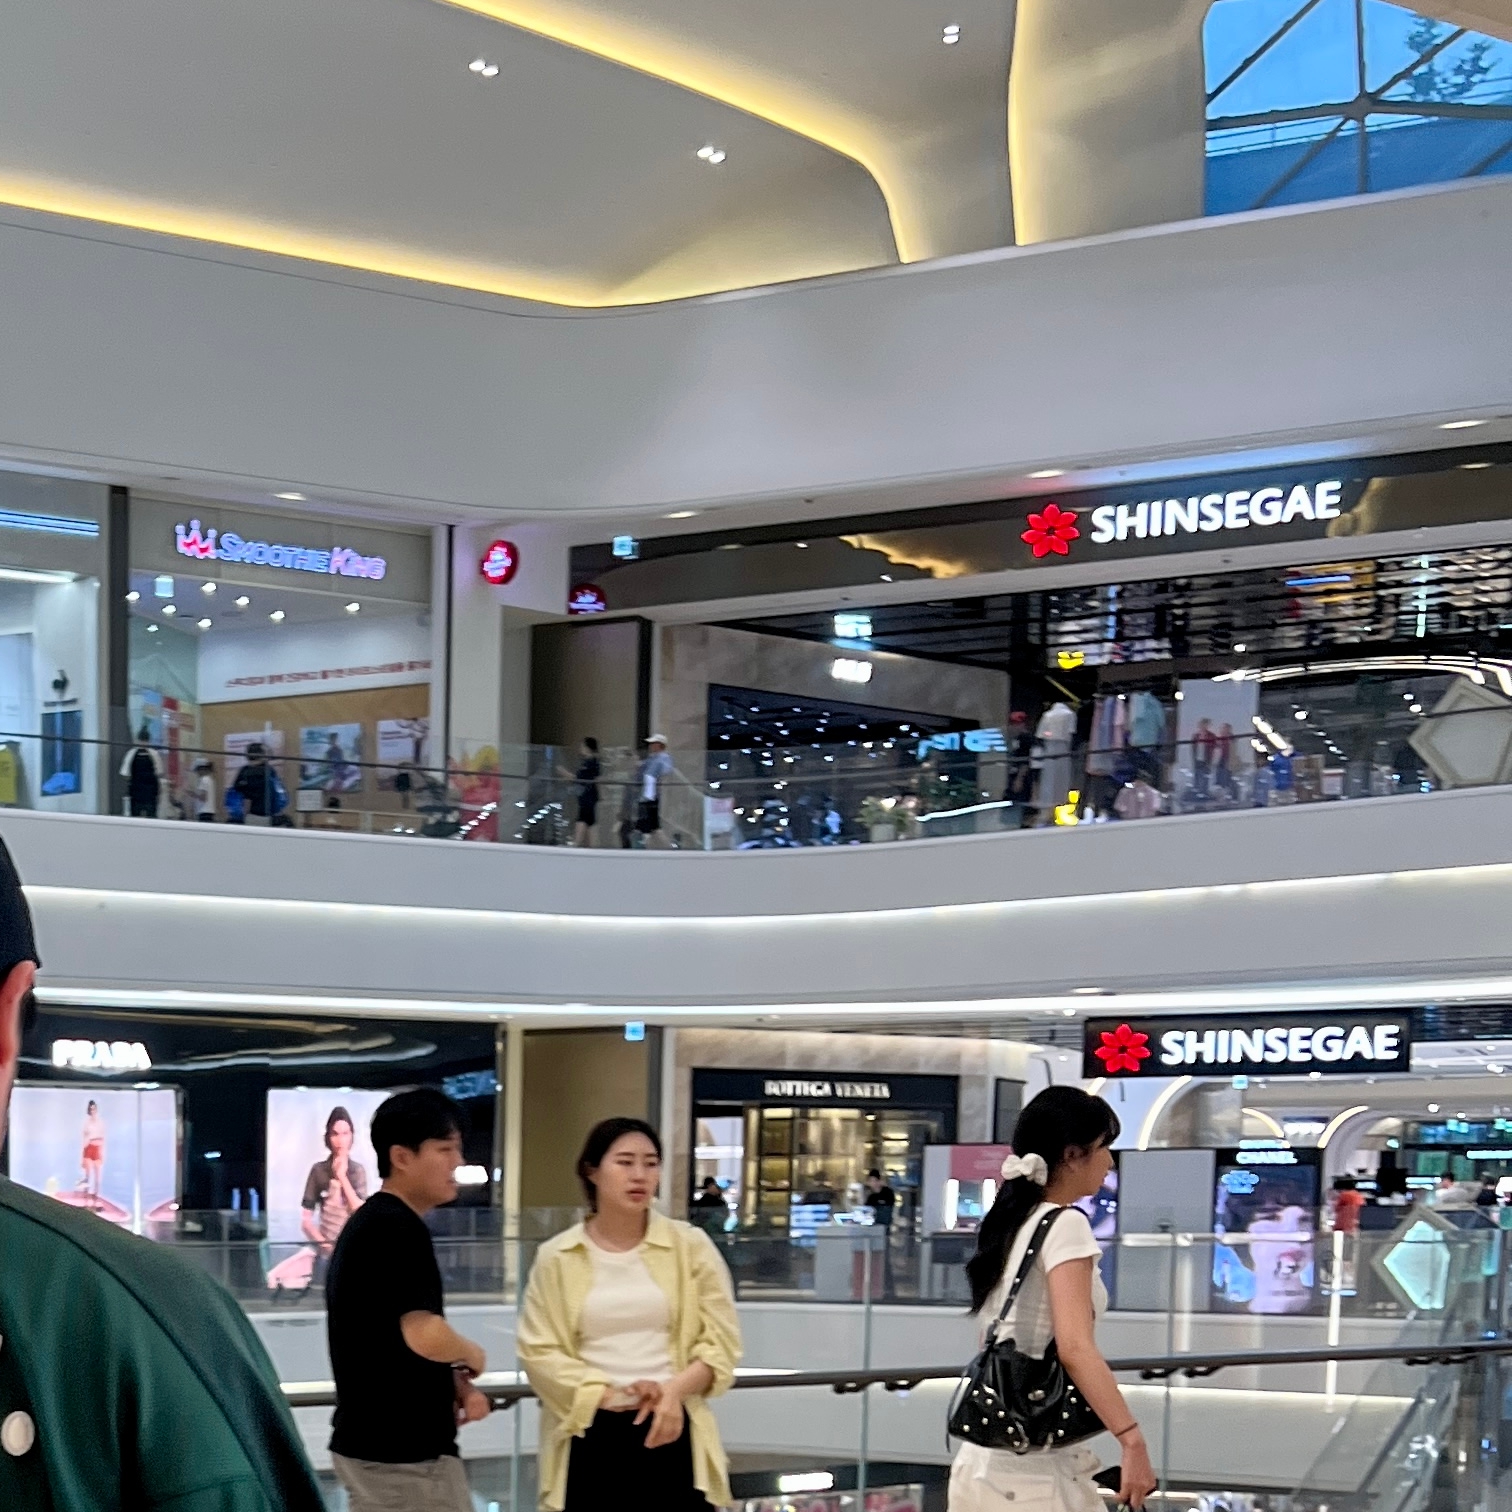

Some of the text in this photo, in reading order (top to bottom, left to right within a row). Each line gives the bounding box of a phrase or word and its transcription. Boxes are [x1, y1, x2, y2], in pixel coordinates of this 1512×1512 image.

[1091, 480, 1342, 544] SHINSEGAE
[52, 1038, 152, 1071] PRADA
[1161, 1025, 1400, 1065] SHINSEGAE
